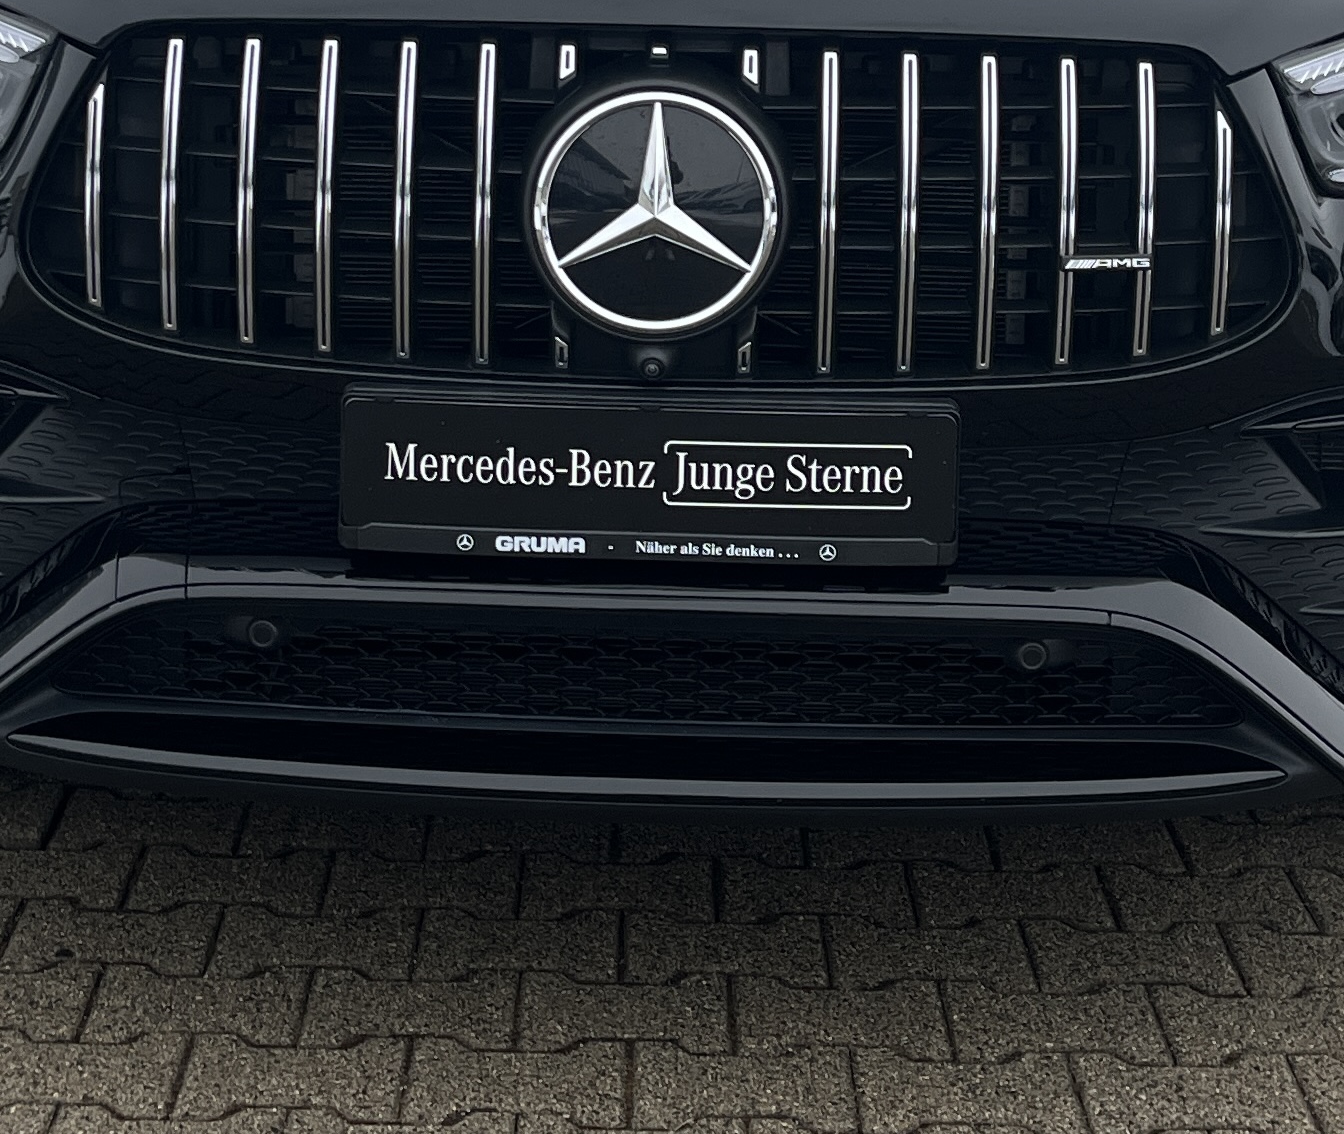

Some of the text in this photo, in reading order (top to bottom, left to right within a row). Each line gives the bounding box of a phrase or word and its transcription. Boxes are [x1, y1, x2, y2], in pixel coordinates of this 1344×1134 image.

[1092, 258, 1150, 269] AMG
[384, 442, 903, 500] Mercedes-Benz Junge Sterne
[495, 535, 586, 554] GRUMA
[635, 540, 677, 555] Näher
[679, 542, 700, 555] als
[702, 542, 723, 556] Sie
[725, 543, 775, 558] denken
